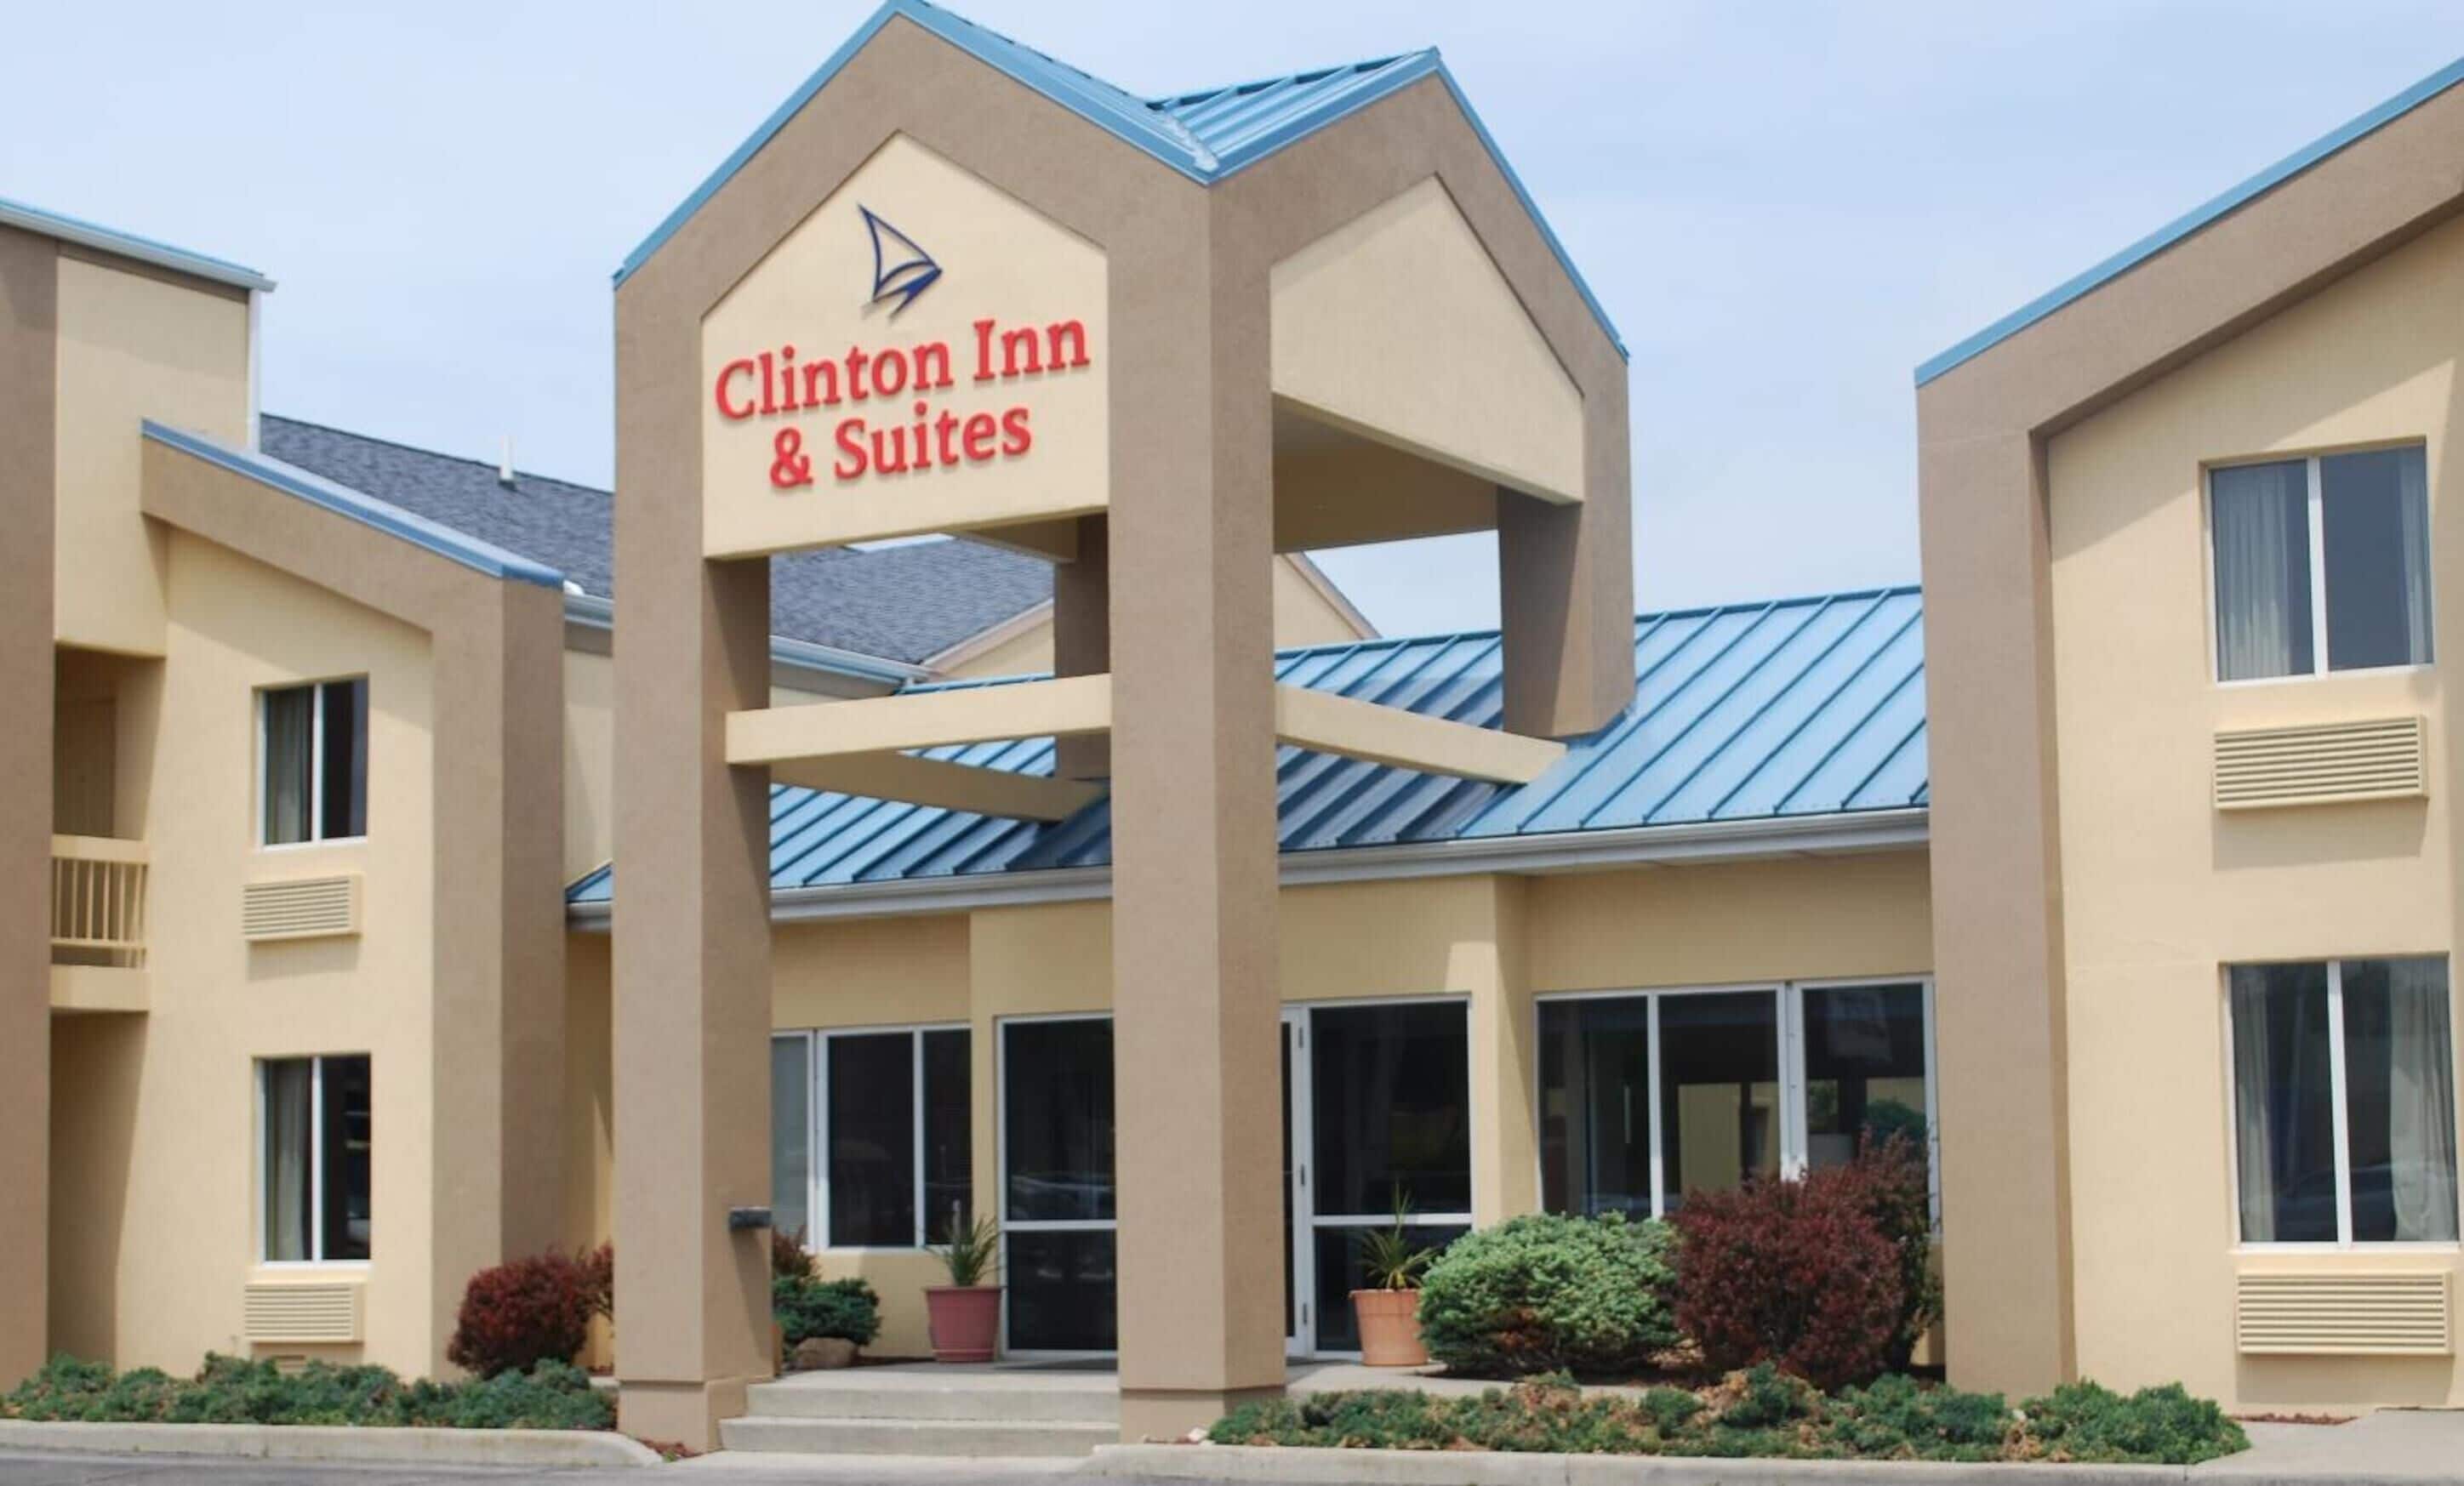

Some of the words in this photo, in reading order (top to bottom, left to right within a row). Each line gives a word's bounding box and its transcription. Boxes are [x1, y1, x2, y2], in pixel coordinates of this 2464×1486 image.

[715, 341, 954, 420] Clinton
[973, 318, 1091, 381] Inn
[768, 426, 813, 488] &
[834, 401, 1033, 481] Suites
